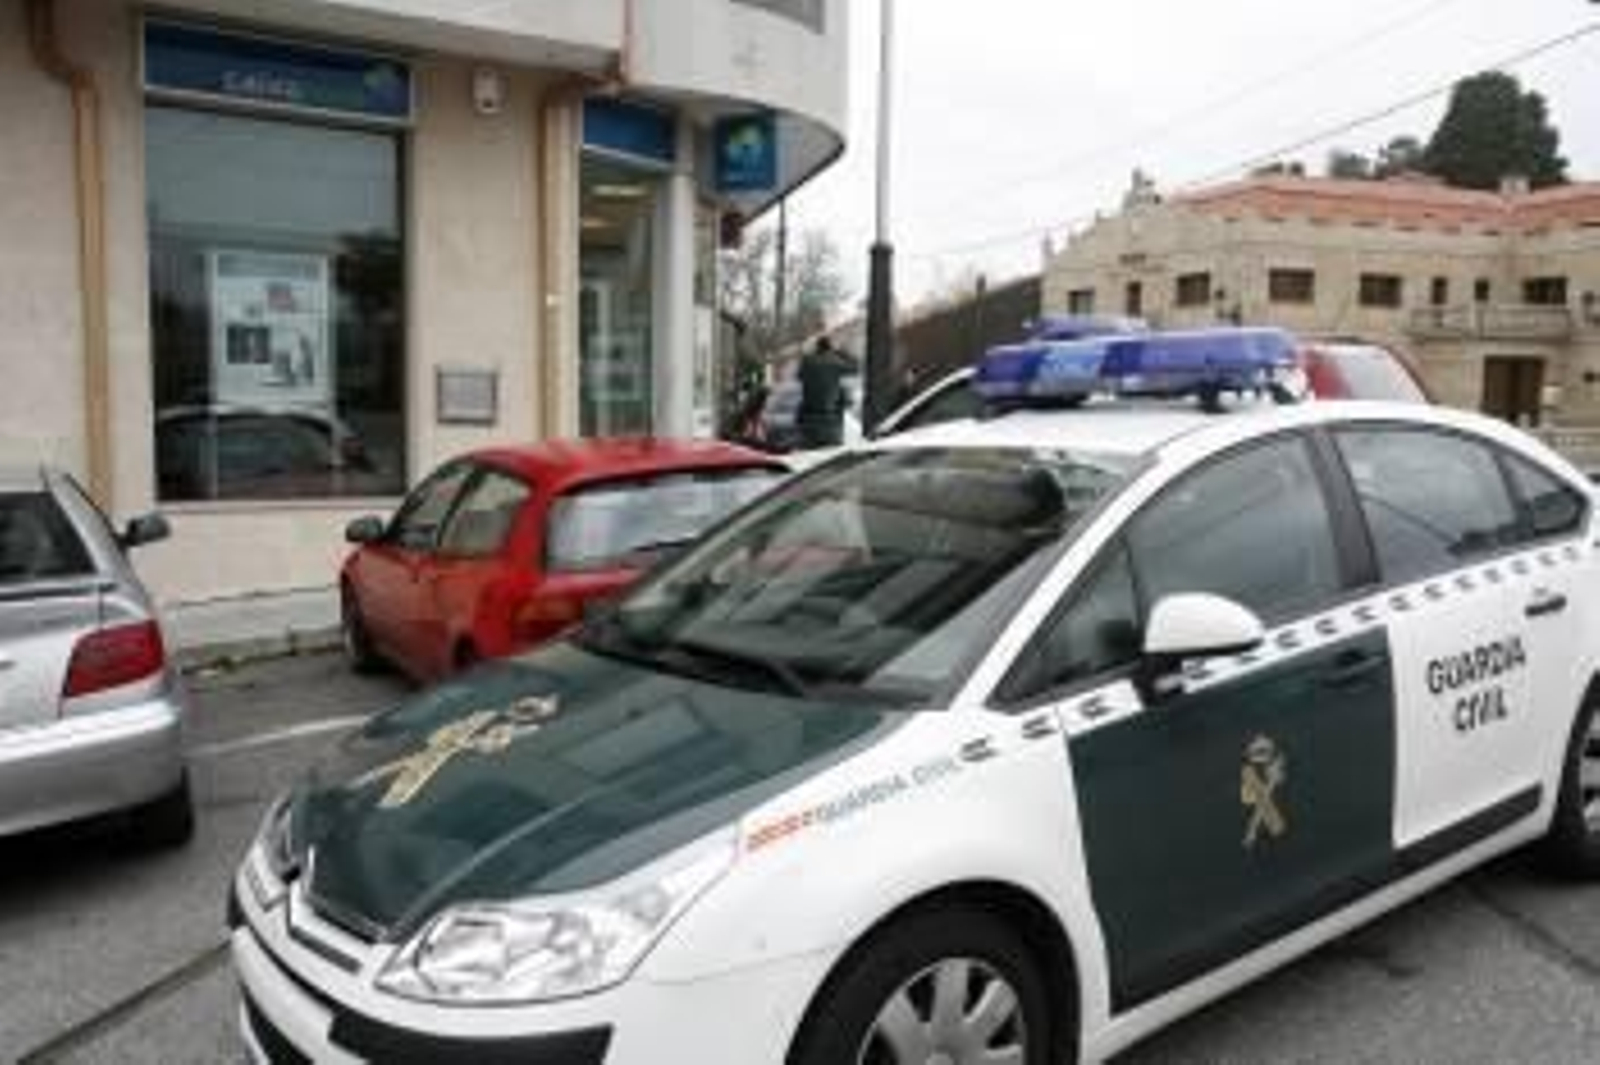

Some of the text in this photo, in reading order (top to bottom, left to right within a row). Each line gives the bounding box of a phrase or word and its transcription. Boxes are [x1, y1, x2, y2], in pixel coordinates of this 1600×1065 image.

[1427, 636, 1526, 694] GUARDIA
[1455, 687, 1507, 732] CIVIL
[816, 773, 908, 823] GUARDIA
